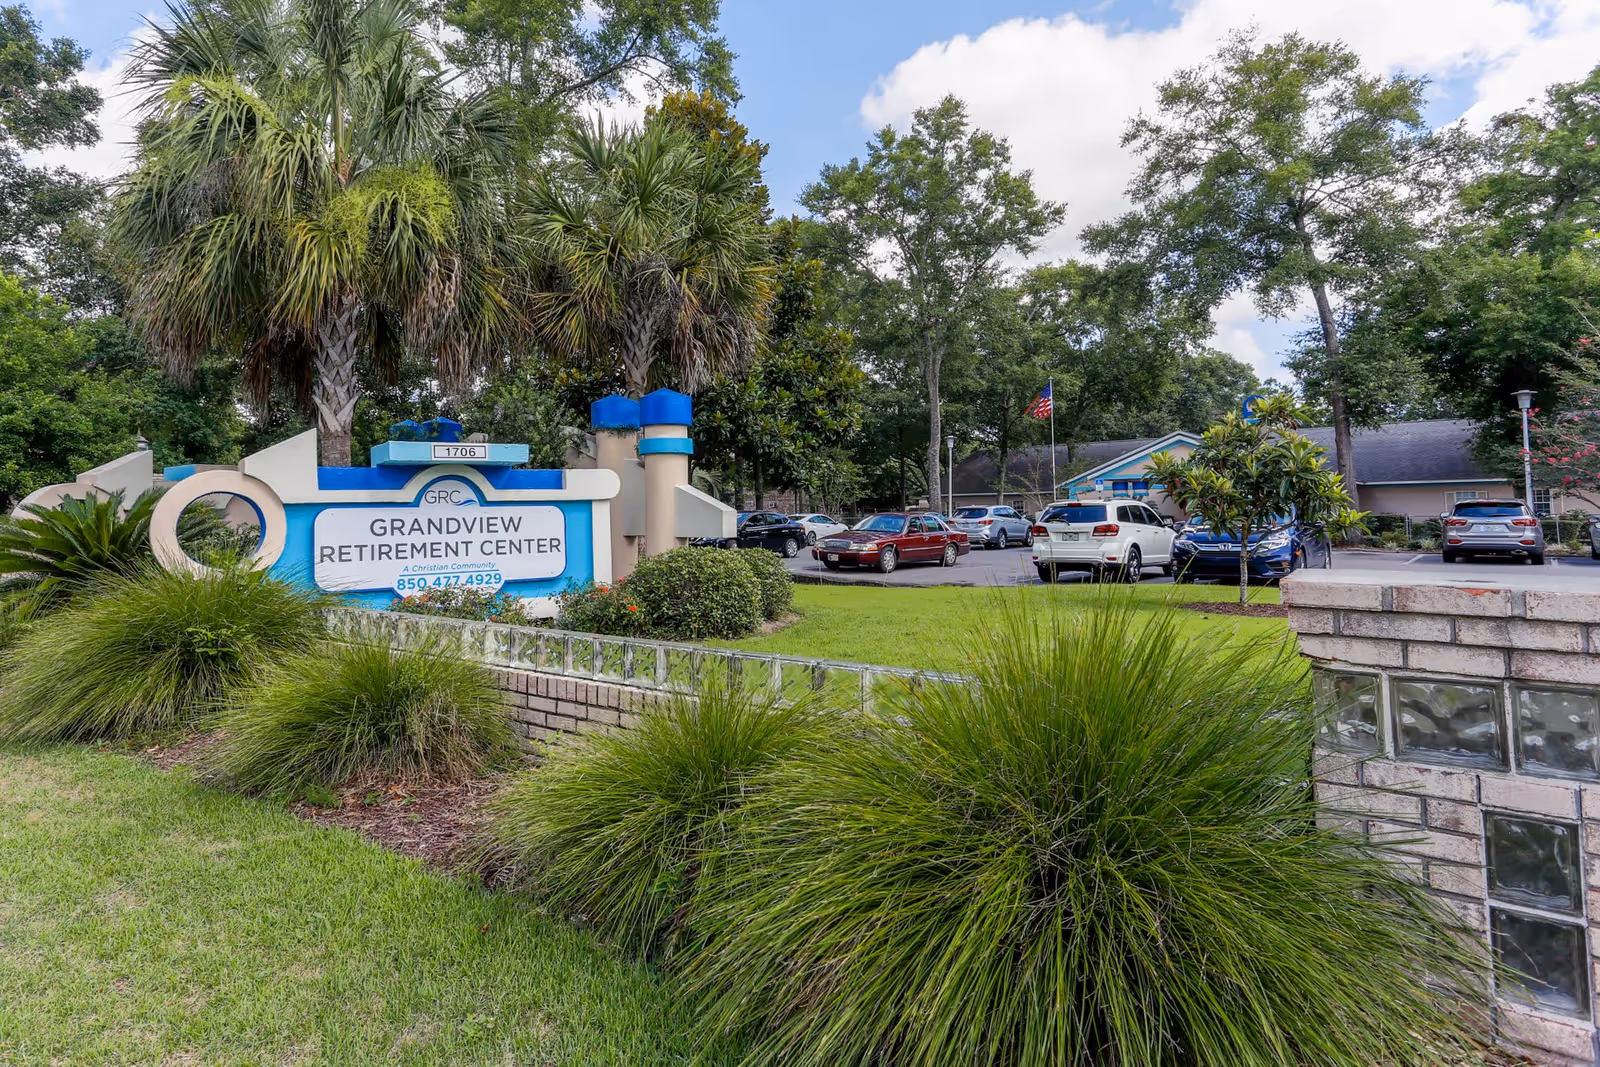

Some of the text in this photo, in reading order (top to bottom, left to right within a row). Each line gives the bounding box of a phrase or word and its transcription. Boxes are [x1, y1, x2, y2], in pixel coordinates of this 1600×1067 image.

[445, 447, 476, 457] 1706
[424, 490, 461, 504] GRC
[369, 516, 522, 537] GRANDVIEW
[319, 538, 561, 563] RETIREMENT CENTER
[412, 563, 449, 573] Christian
[451, 561, 496, 571] Community
